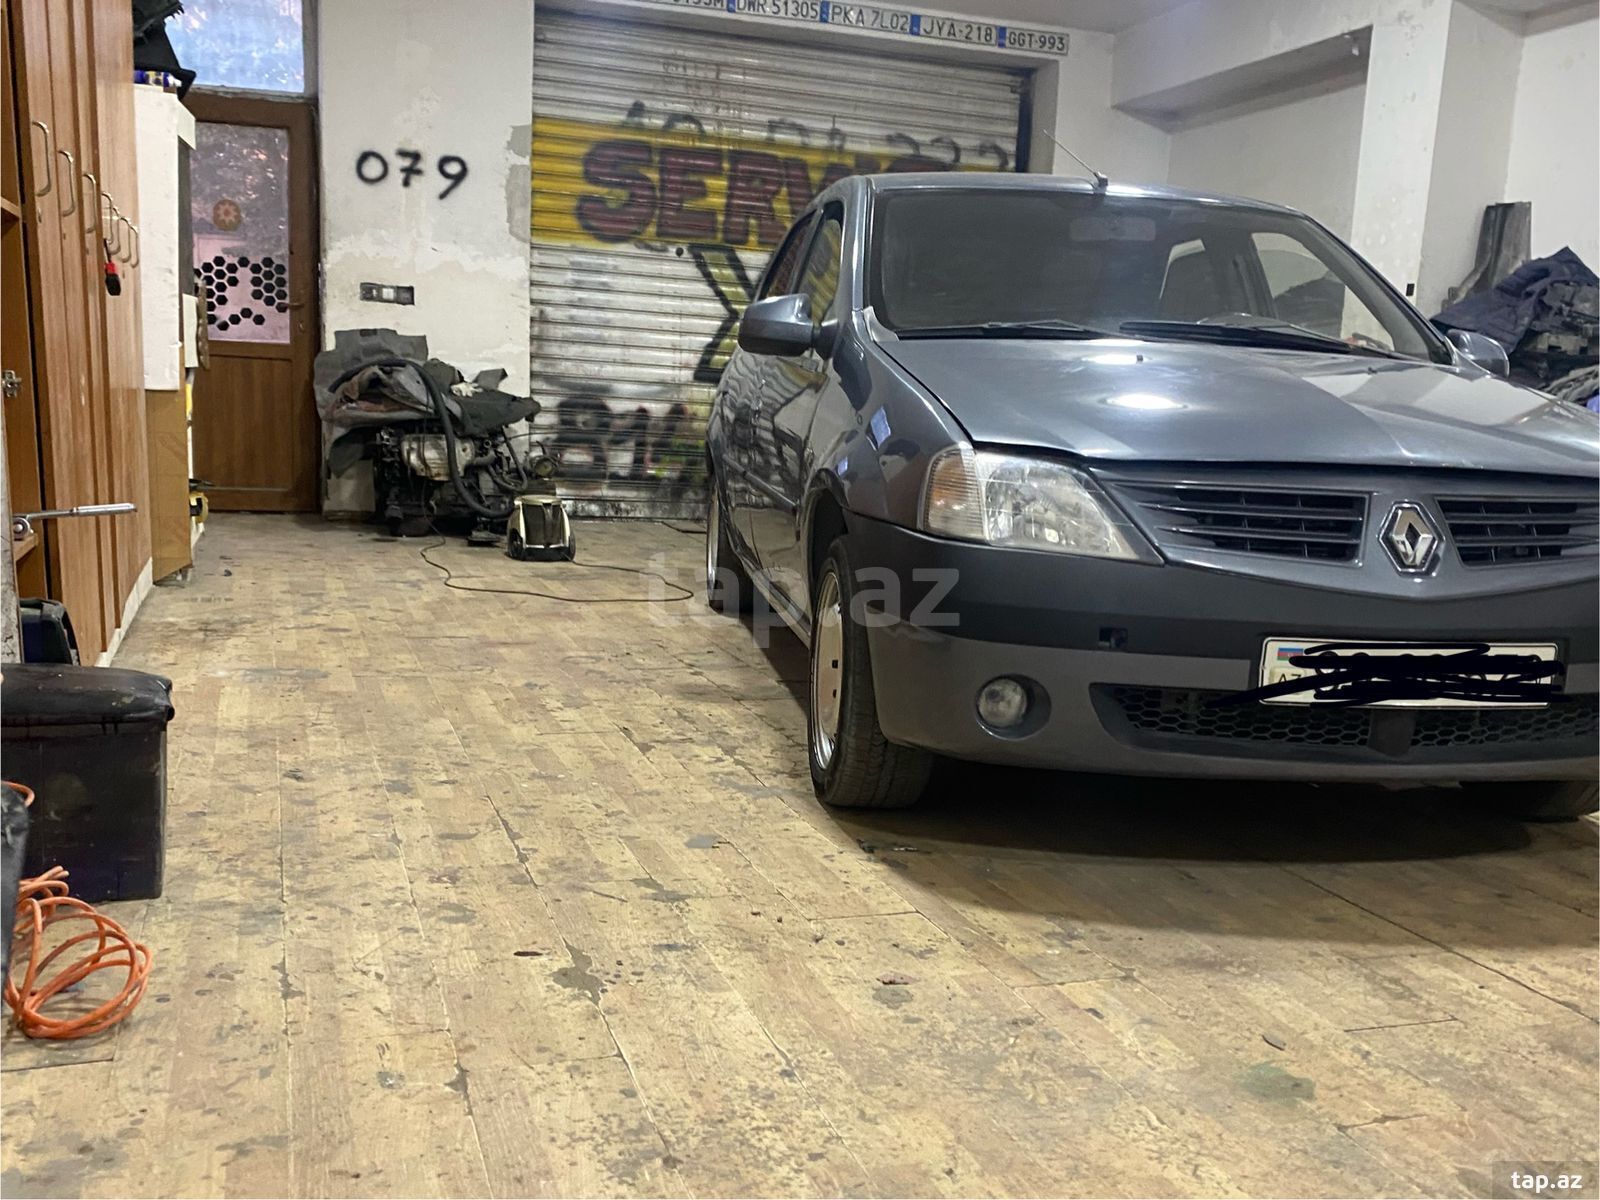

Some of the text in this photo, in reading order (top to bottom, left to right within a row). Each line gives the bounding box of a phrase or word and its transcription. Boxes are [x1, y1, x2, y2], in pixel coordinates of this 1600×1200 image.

[737, 0, 765, 13] DWR
[771, 0, 819, 19] 51305
[832, 5, 865, 26] PKA
[923, 19, 993, 43] JYA-218
[1008, 32, 1066, 51] GGT-993
